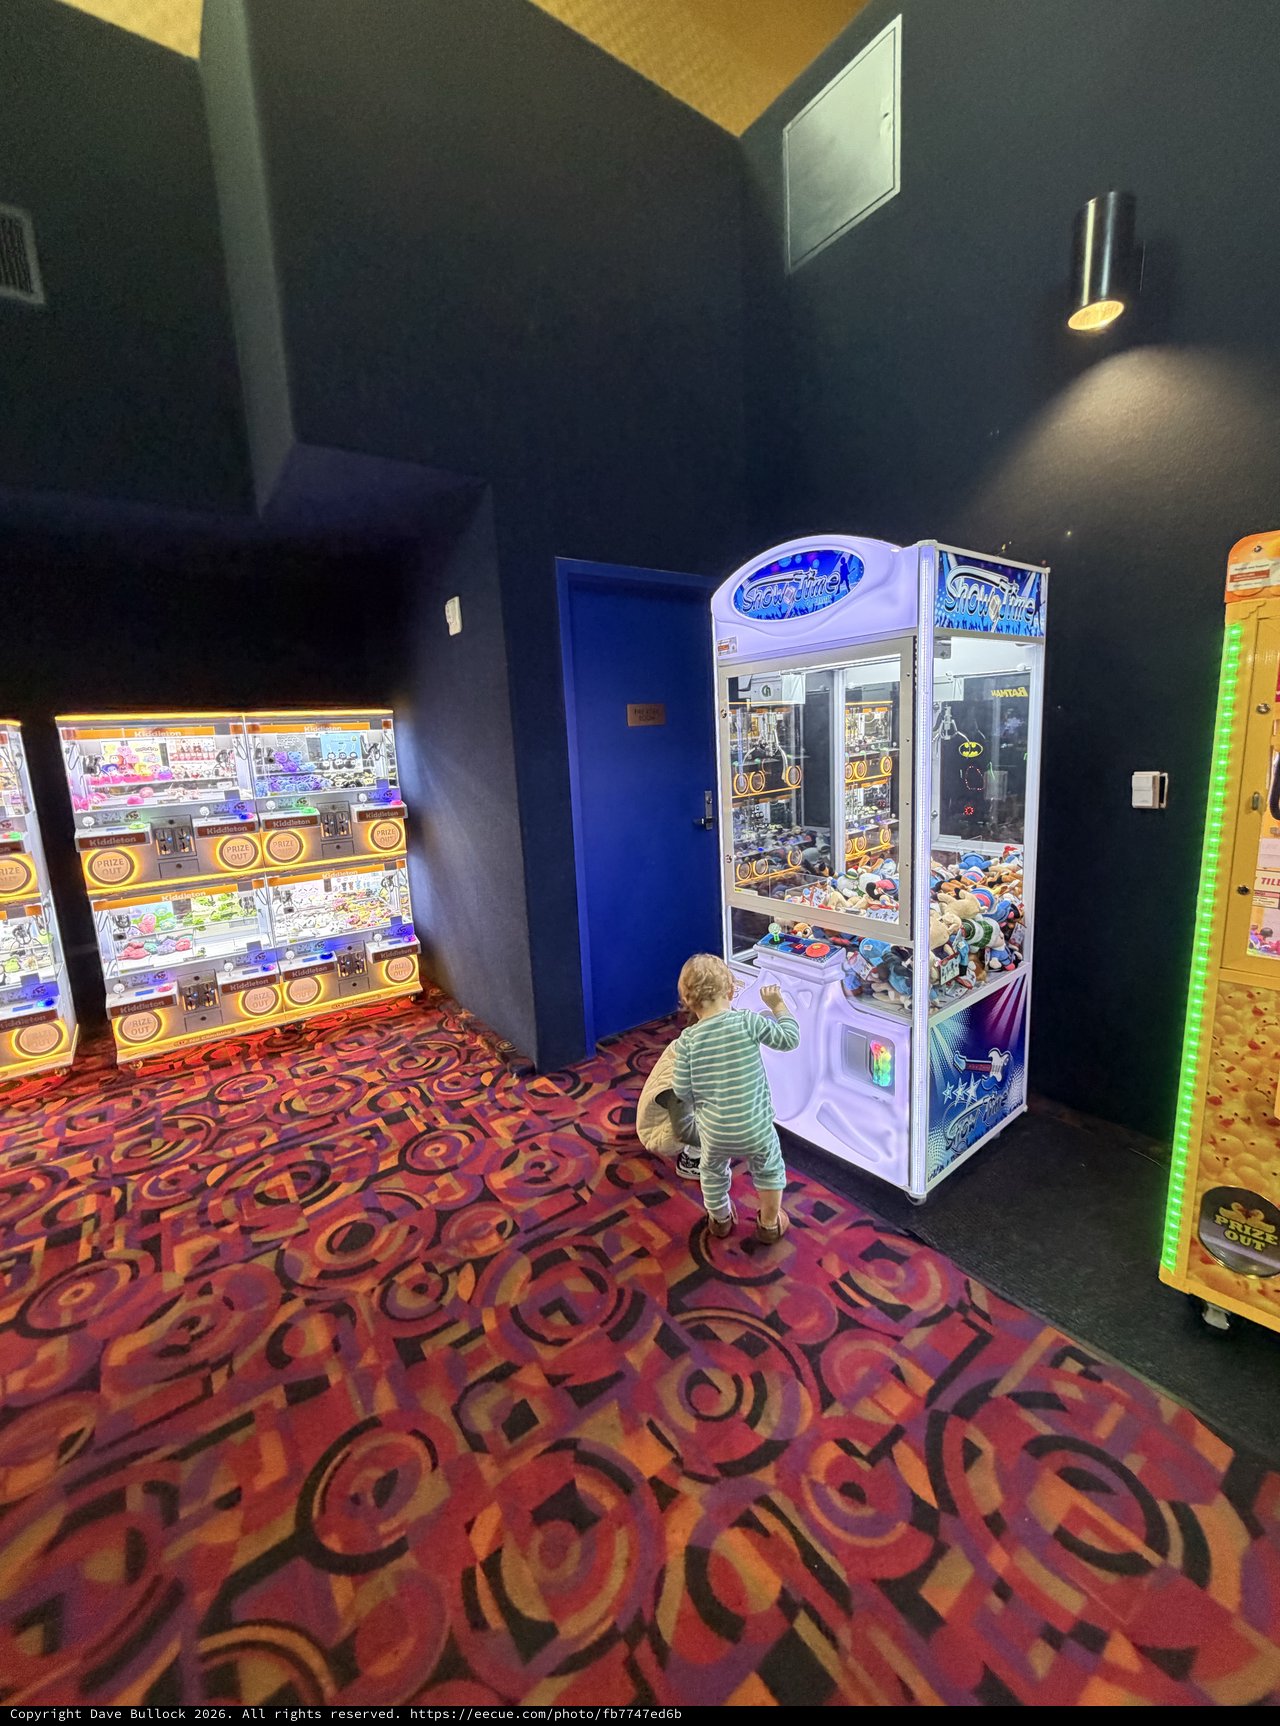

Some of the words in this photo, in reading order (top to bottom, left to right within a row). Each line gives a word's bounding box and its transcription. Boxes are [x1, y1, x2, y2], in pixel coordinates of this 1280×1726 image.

[365, 810, 399, 819] Kiddleton
[272, 818, 311, 828] Kiddleton
[206, 825, 247, 835] Kiddleton
[376, 828, 396, 837] PRIZE
[89, 836, 137, 848] Kiddleton
[226, 845, 250, 854] PRIZE
[230, 853, 249, 861] OUT
[96, 858, 125, 868] PRIZE
[102, 867, 122, 876] OUT
[380, 948, 412, 959] Kiddleton
[292, 966, 328, 977] Kiddleton
[229, 979, 269, 990] Kiddleton
[119, 1000, 165, 1014] Kiddleton
[252, 1000, 269, 1008] OUT
[131, 1026, 150, 1036] OUT
[1214, 1214, 1278, 1246] PRIZE
[1224, 1229, 1266, 1252] OUT
